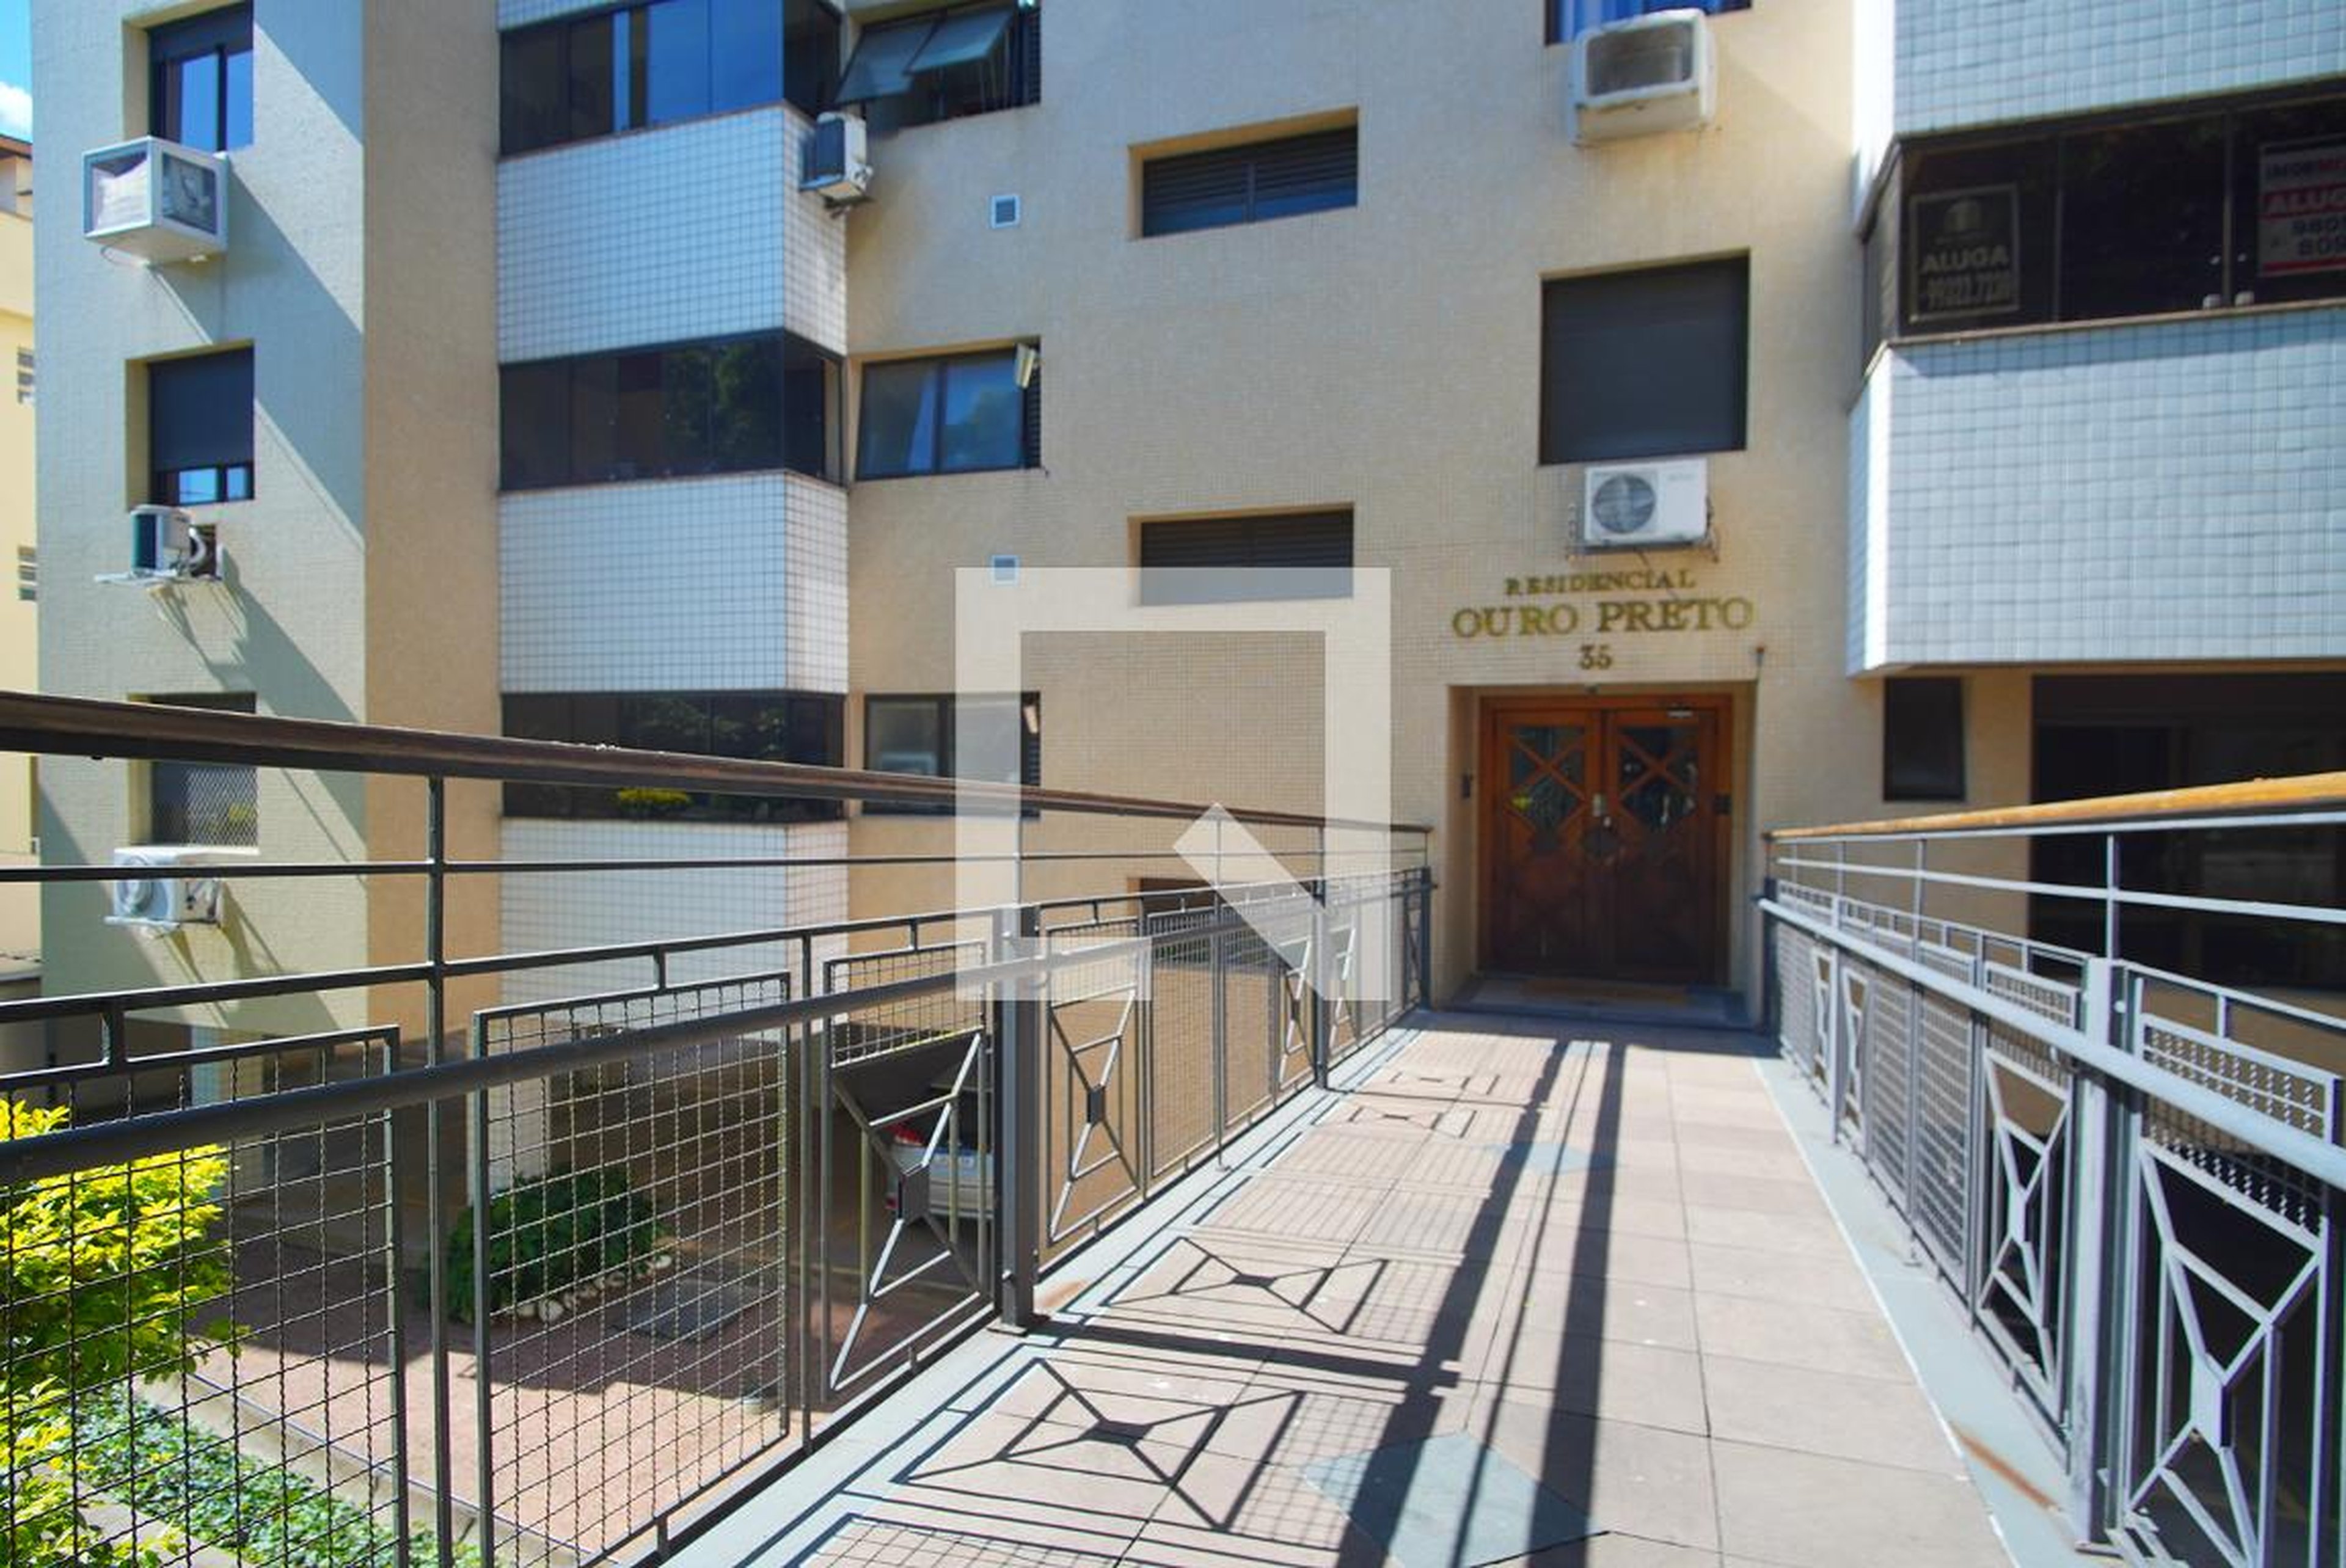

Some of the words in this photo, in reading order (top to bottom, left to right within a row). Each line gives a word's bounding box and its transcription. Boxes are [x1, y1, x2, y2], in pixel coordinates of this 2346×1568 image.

[1922, 246, 2009, 272] ALUGA
[1505, 569, 1697, 595] RESIDENCIAL
[1452, 603, 1579, 638] OURO
[1596, 598, 1754, 632] PRETO
[1580, 645, 1613, 670] 35
